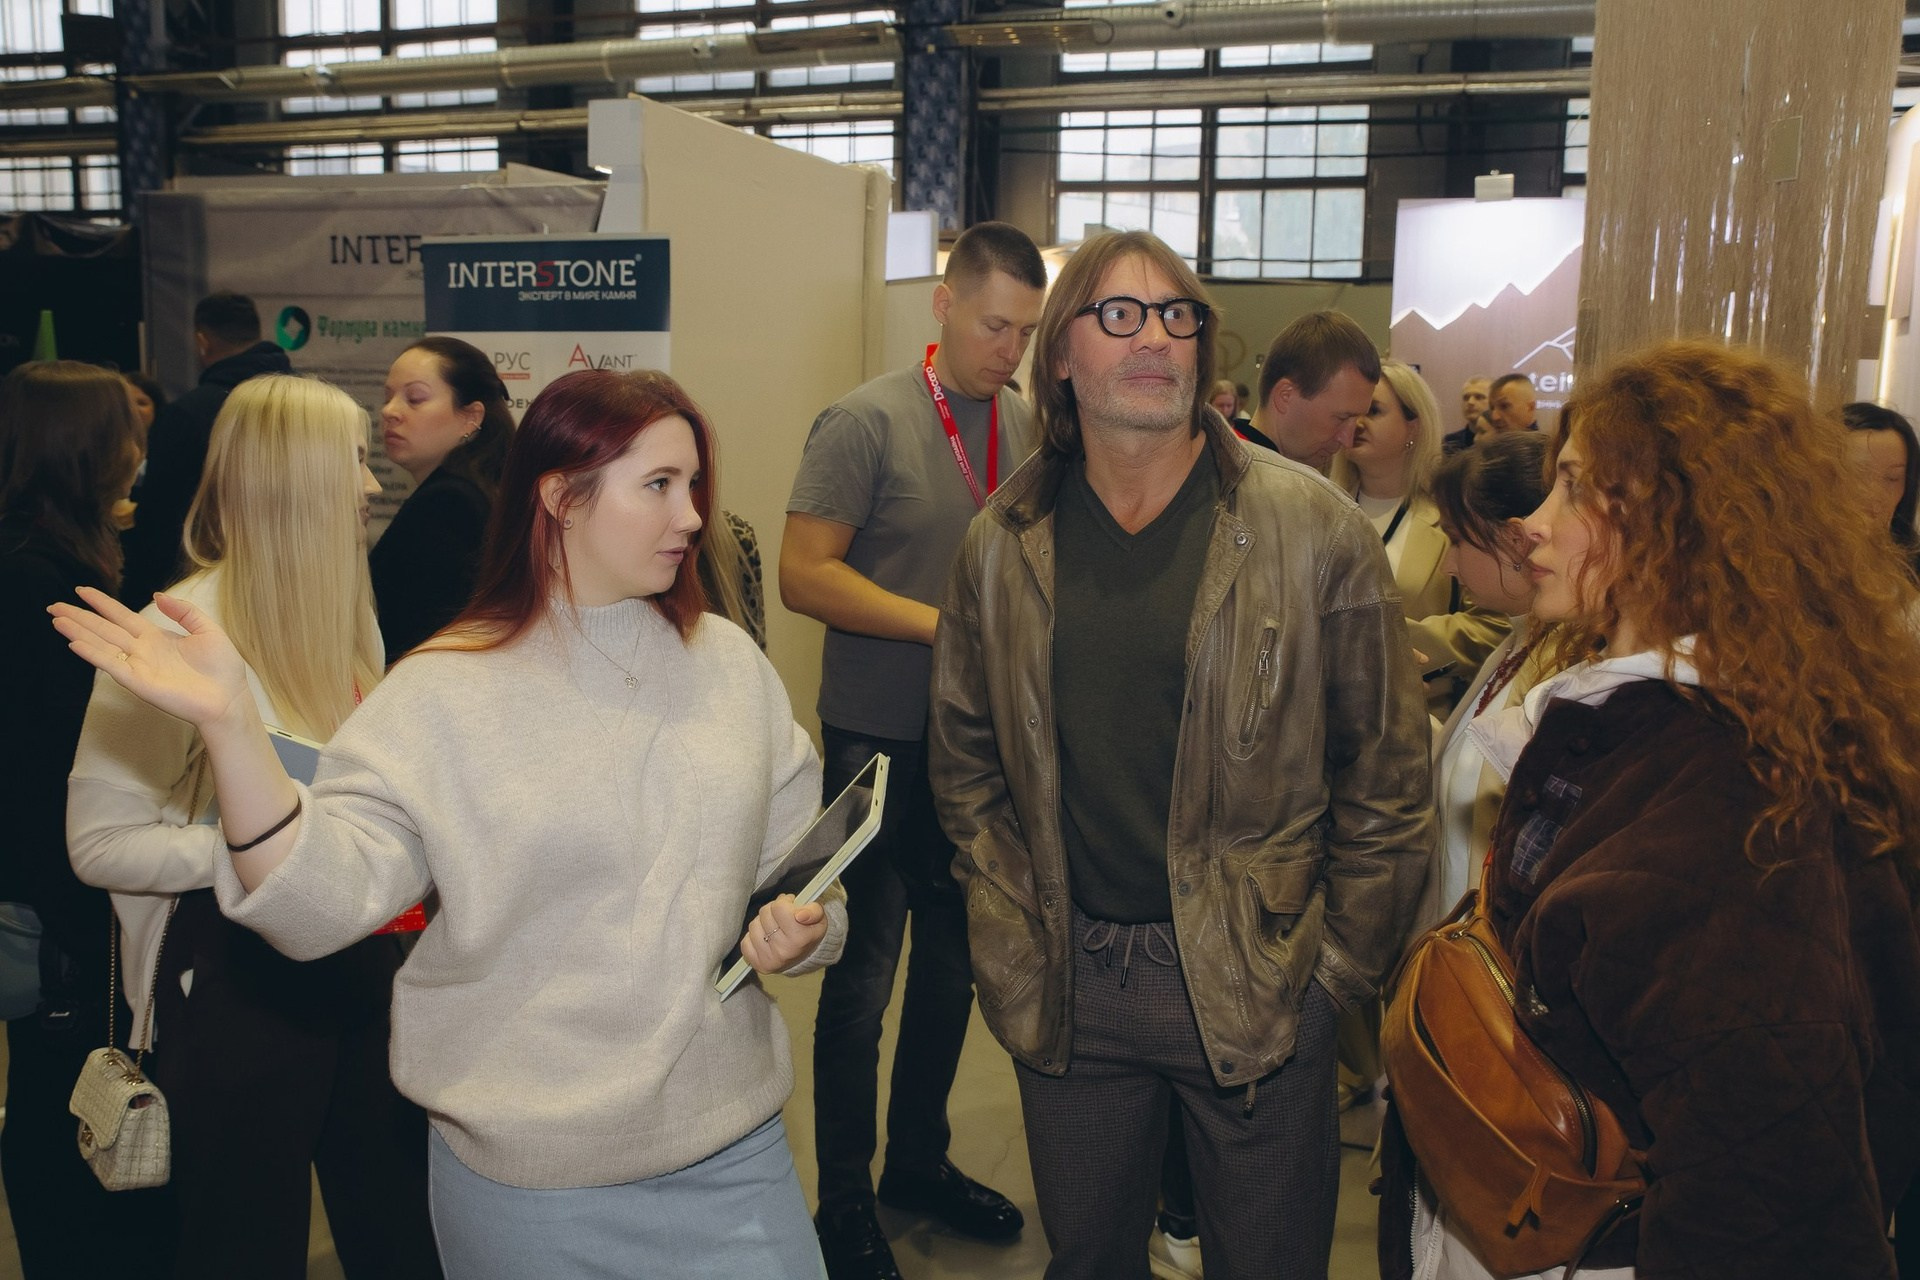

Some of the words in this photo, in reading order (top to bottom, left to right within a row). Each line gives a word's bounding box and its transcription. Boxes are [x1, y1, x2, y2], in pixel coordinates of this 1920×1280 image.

[572, 290, 600, 301] МИРЕ
[602, 290, 637, 300] КАМНЯ
[926, 366, 944, 401] Decaro
